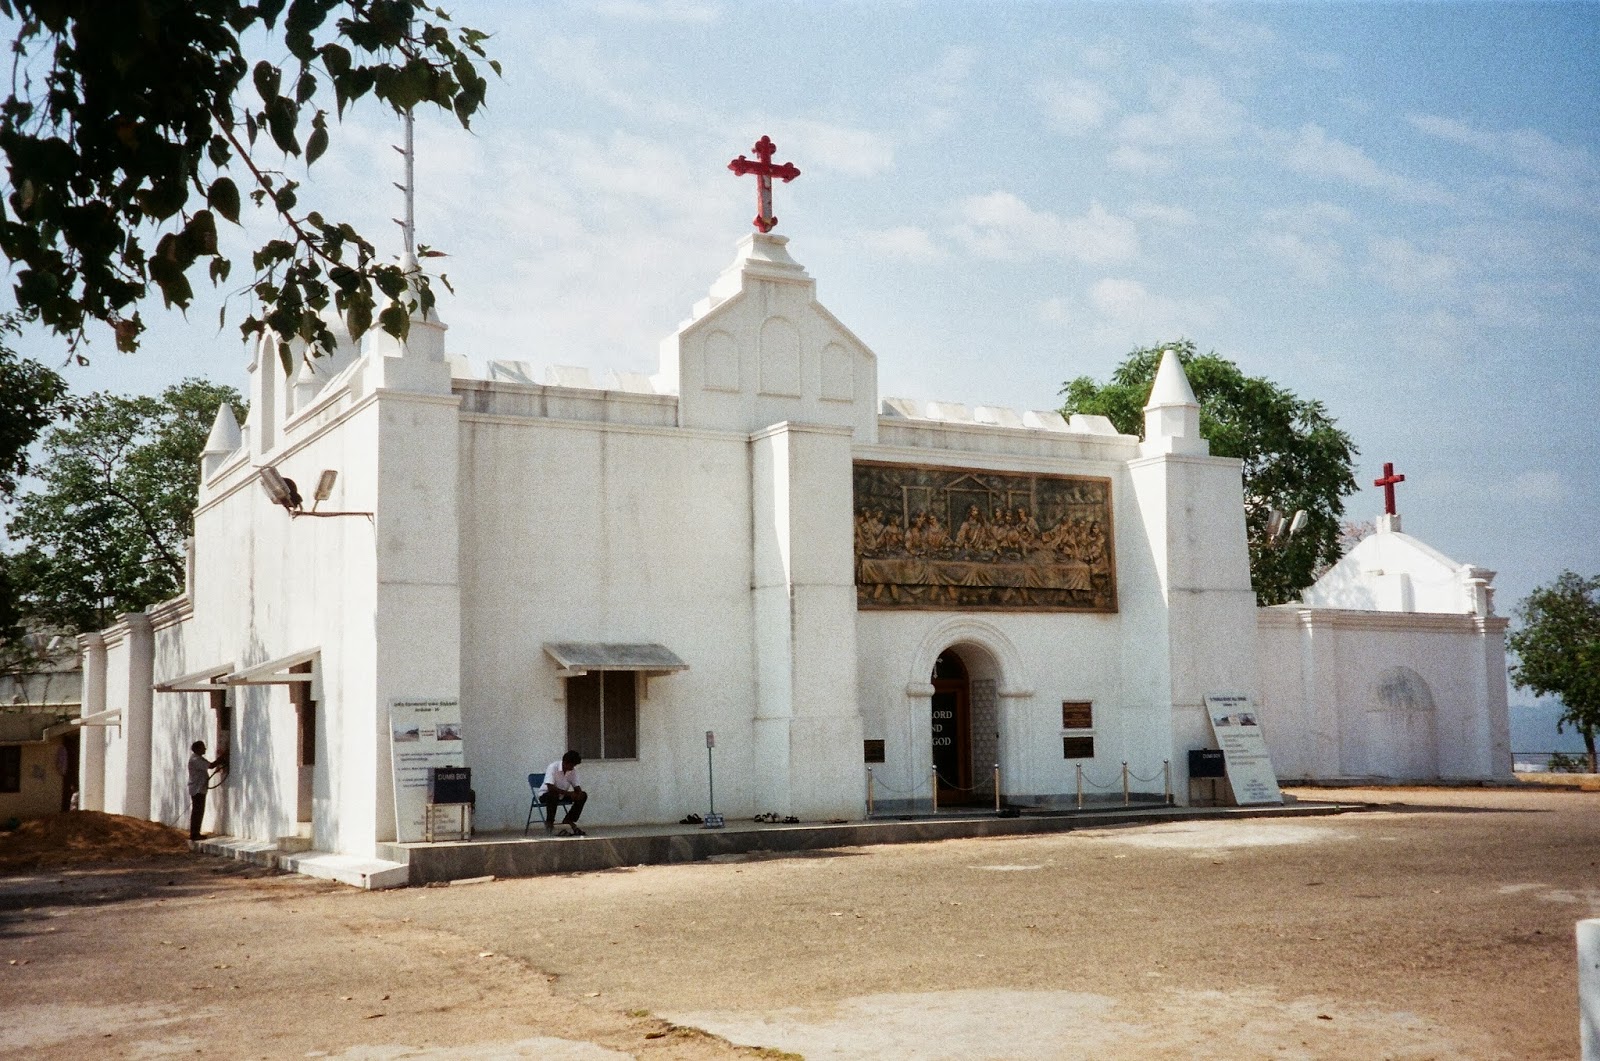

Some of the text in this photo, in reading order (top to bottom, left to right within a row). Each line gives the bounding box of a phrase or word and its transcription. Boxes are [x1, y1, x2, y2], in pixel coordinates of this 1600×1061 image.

[931, 710, 953, 719] ORD
[931, 724, 943, 733] ND
[932, 737, 951, 746] GOD
[437, 773, 455, 781] DUMB
